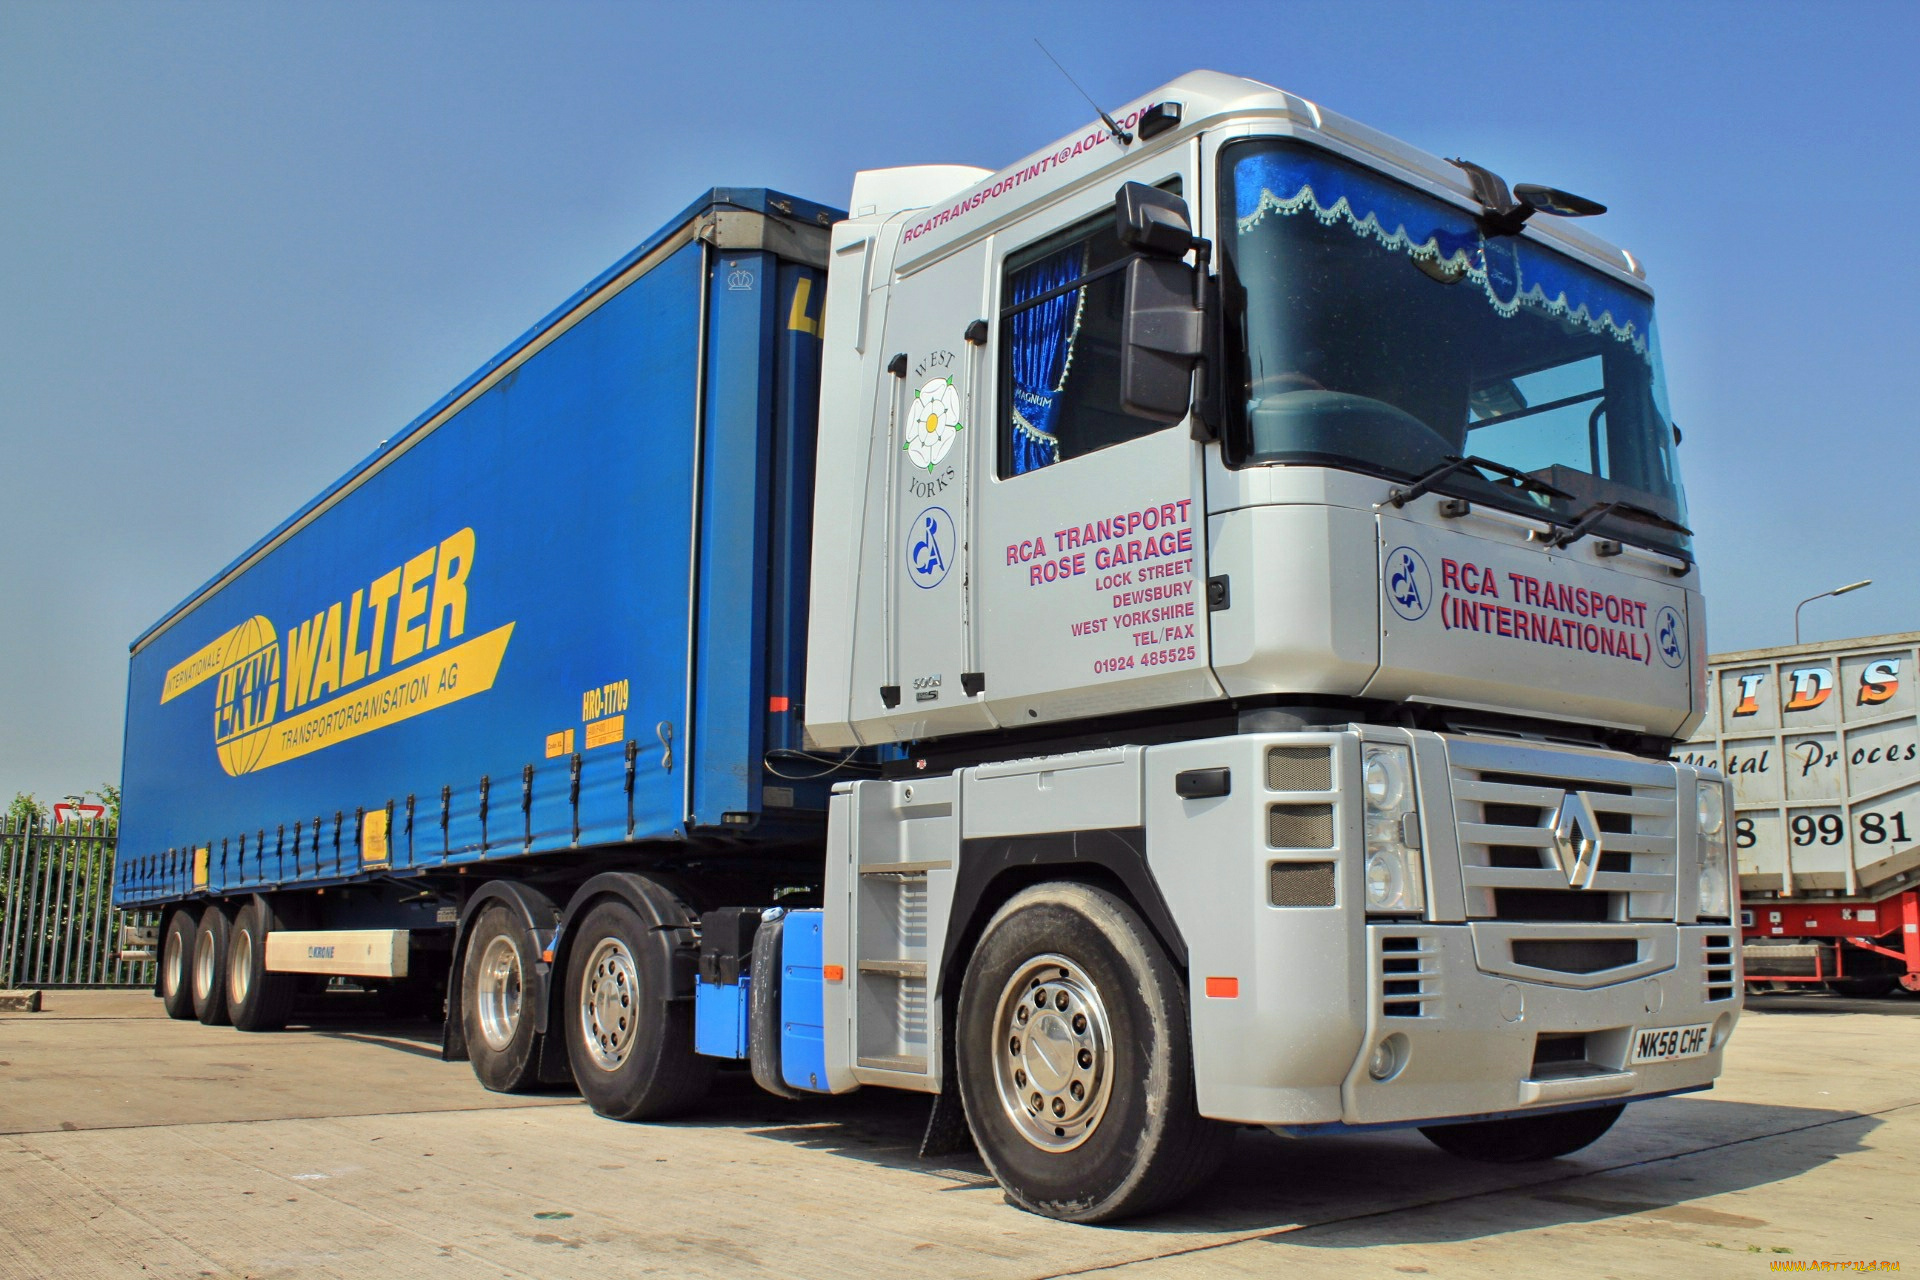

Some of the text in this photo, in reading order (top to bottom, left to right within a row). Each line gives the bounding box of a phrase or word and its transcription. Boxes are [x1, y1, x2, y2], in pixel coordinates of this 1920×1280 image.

[787, 277, 826, 339] L
[915, 350, 956, 378] WEST
[1015, 388, 1053, 408] MAGNUM
[909, 465, 955, 498] YORKS
[1006, 498, 1192, 566] RCA TRANSPORT
[1029, 528, 1193, 587] ROSE GARAGE
[1095, 558, 1193, 591] LOCK STREET
[1112, 581, 1194, 609] DEWSBURY
[1441, 557, 1648, 629] RCA TRANSPORT
[285, 527, 476, 713] WALTER
[1071, 601, 1195, 637] WEST YORKSHIRE
[1133, 624, 1195, 647] TEL/FAX
[1441, 592, 1651, 666] (INTERNATIONAL)
[164, 646, 222, 695] INTERNATIONALE
[1094, 646, 1196, 675] 01924 485525
[216, 645, 279, 741] LKW
[281, 662, 459, 752] TRANSPORTORGANISATION AG
[1706, 658, 1901, 717] IDS
[1637, 1027, 1707, 1058] NK58 CHF
